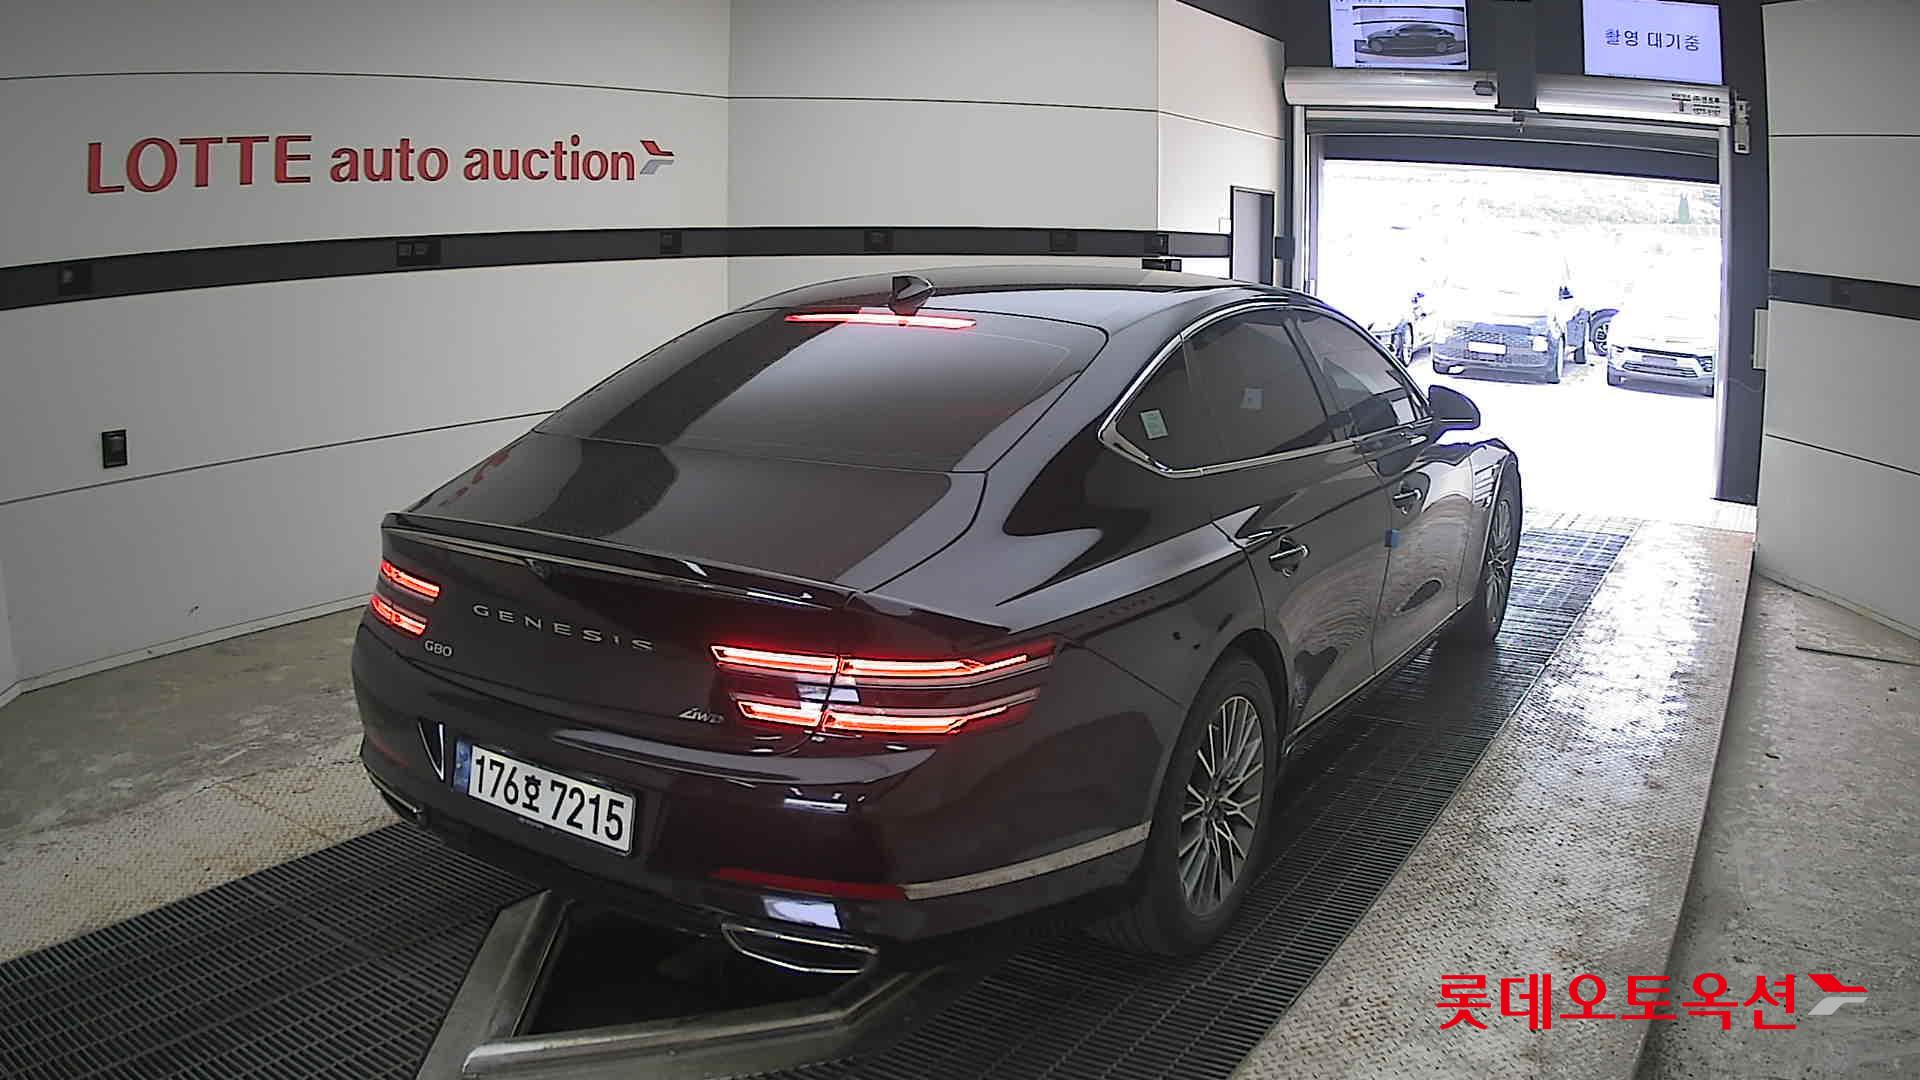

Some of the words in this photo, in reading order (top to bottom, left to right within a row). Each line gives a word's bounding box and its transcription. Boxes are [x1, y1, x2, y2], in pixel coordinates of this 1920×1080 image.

[1647, 32, 1701, 52] 대기중
[87, 135, 313, 194] LOTTE
[330, 138, 450, 183] auto
[463, 134, 636, 182] auction
[425, 640, 452, 657] G80
[472, 603, 655, 652] GENESIS
[549, 781, 626, 842] 7215
